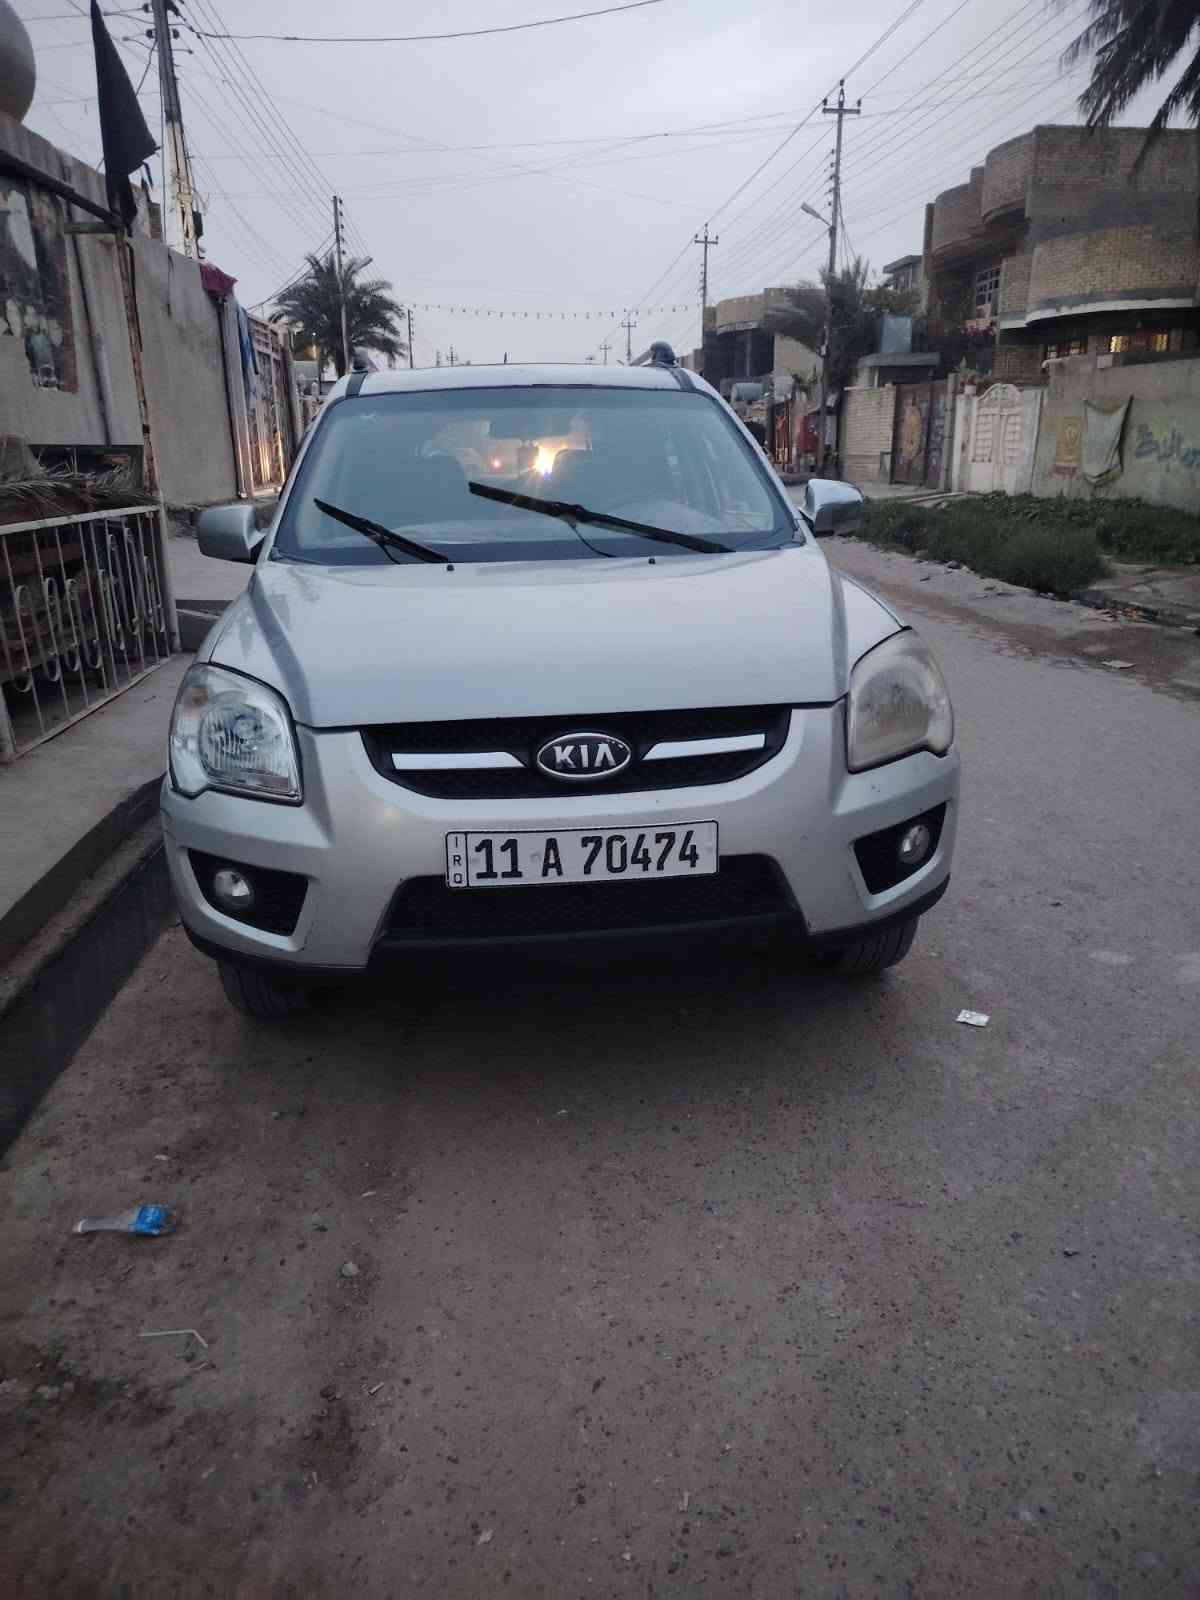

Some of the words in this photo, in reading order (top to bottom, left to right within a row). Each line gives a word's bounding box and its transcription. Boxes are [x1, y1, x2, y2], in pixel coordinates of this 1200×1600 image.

[553, 743, 617, 768] KIA
[475, 838, 523, 880] 11
[541, 837, 564, 878] A
[581, 830, 699, 875] 70474
